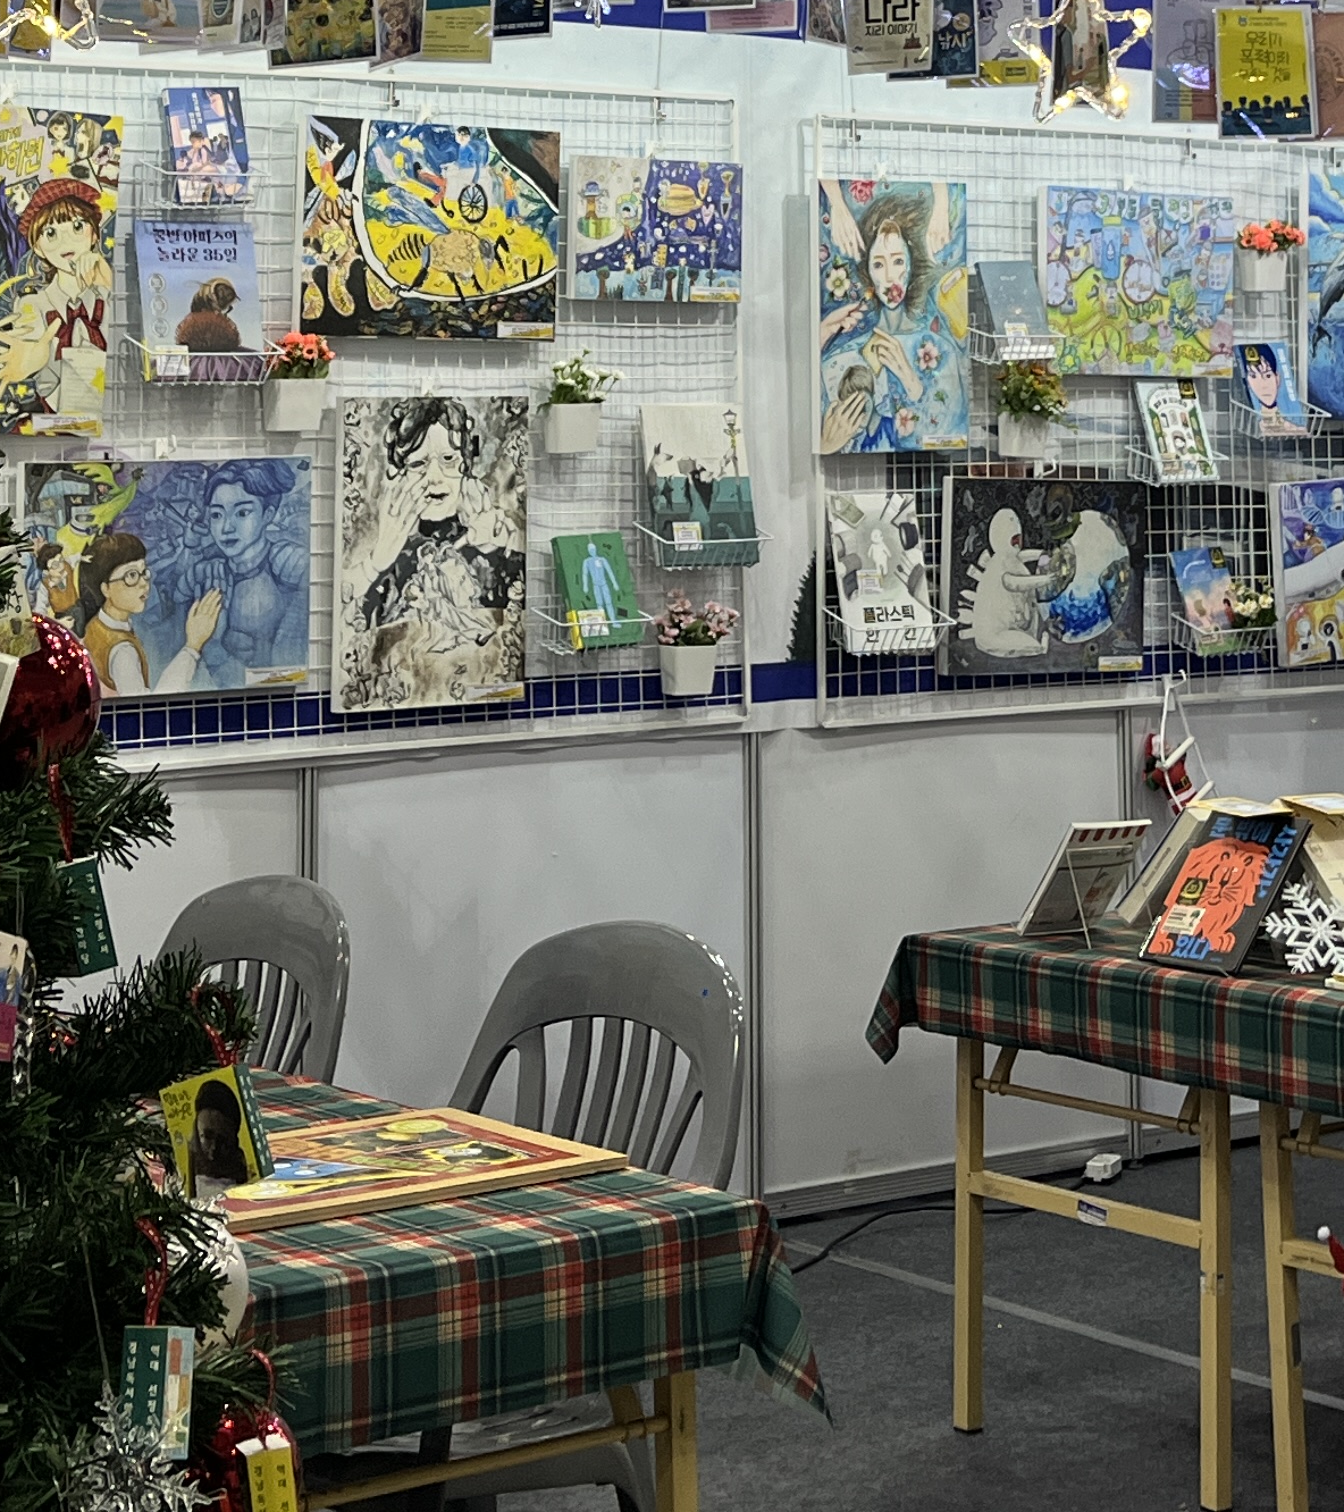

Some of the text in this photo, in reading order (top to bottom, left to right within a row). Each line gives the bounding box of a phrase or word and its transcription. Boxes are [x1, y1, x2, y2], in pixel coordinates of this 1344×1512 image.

[203, 247, 238, 263] 35일
[863, 605, 915, 624] 플라스틱
[1170, 935, 1211, 961] 있다
